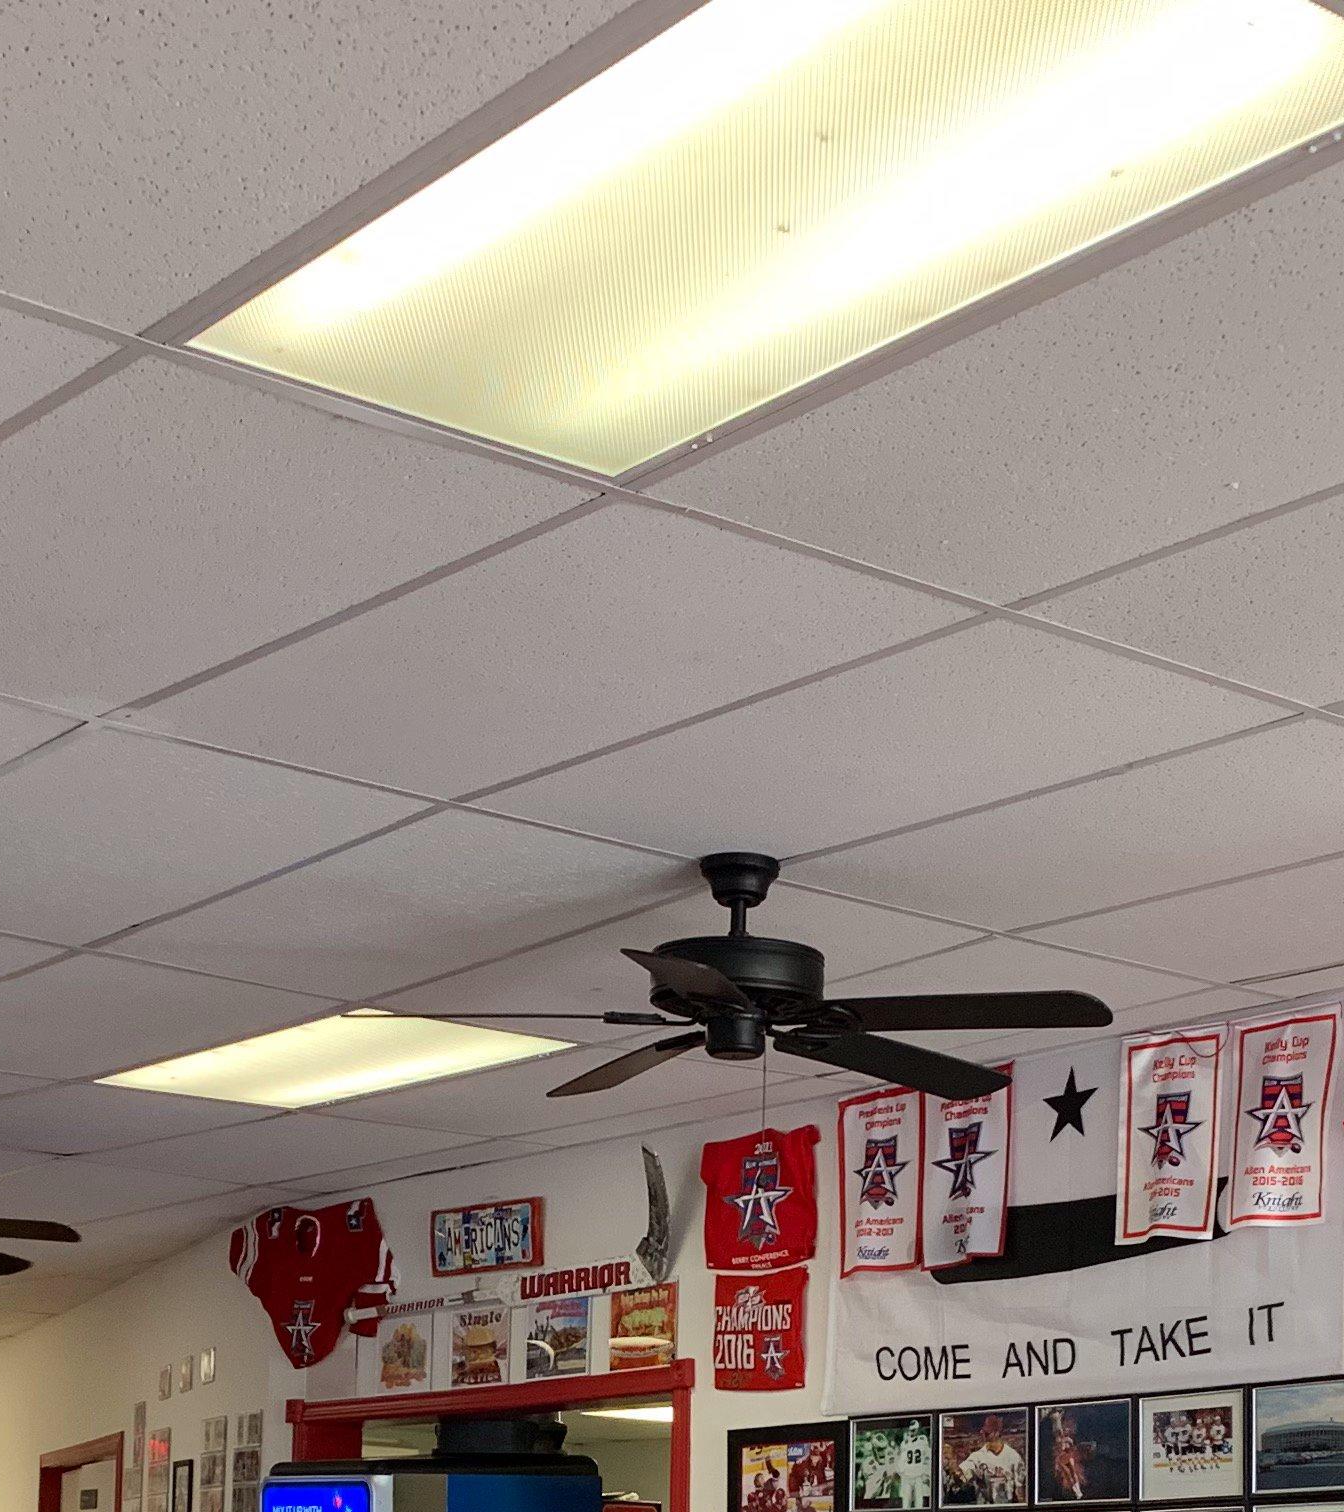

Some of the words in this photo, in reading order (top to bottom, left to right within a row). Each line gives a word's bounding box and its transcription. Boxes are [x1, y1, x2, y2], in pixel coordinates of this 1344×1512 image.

[1292, 1035, 1309, 1048] Cup
[1178, 1054, 1197, 1067] Cup
[1252, 1191, 1304, 1208] Knight
[447, 1218, 520, 1256] AMERICANS
[750, 1250, 789, 1263] CONFERENCE
[521, 1262, 632, 1300] WARRIOR
[459, 1310, 502, 1327] Single
[716, 1304, 792, 1332] CHAMPIONS
[875, 1344, 972, 1381] COME
[1002, 1338, 1076, 1379] AND
[1110, 1315, 1212, 1367] TAKE
[1247, 1302, 1285, 1346] IT
[715, 1334, 755, 1369] 2016
[907, 1450, 922, 1464] 92
